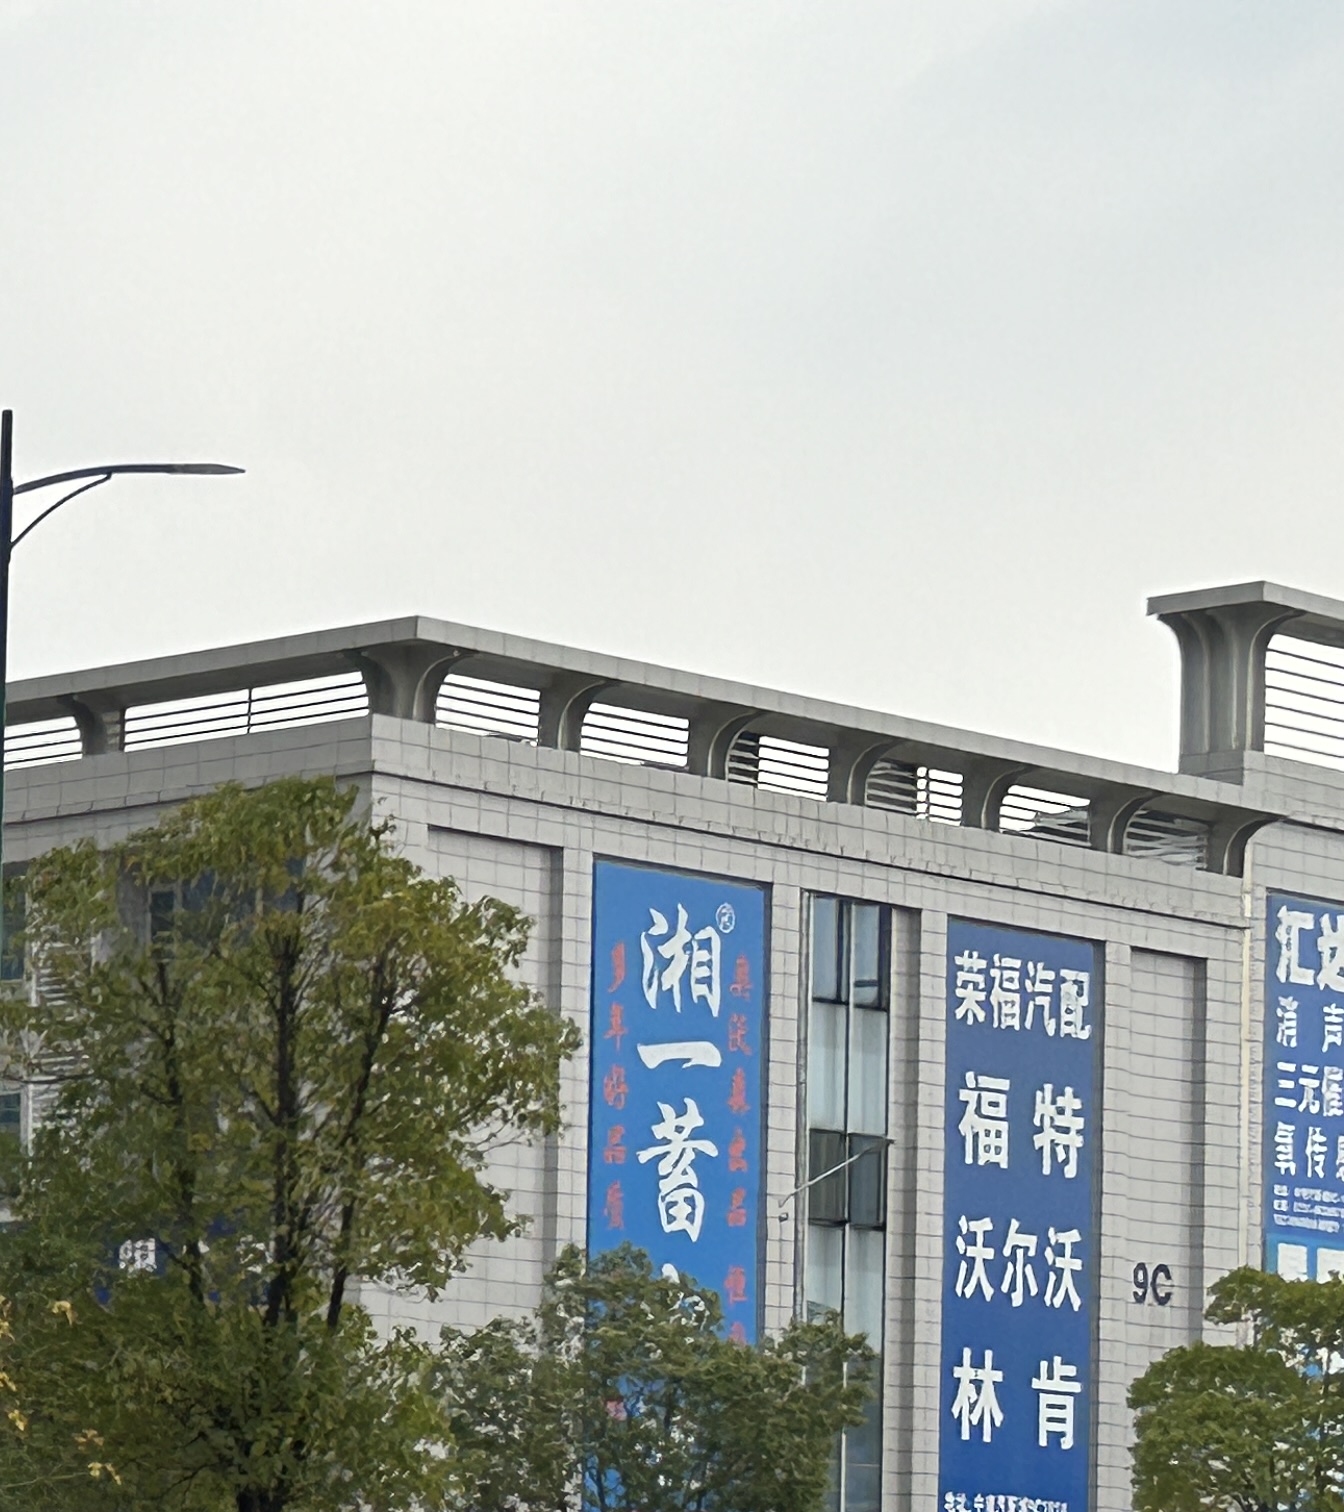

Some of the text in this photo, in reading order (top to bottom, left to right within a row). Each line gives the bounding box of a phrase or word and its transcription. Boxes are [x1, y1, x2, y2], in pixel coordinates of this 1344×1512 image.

[953, 950, 1092, 1040] 荣福汽配
[635, 903, 723, 1283] 湘一蓄
[958, 1070, 1085, 1179] 福特
[955, 1214, 1083, 1312] 沃尔沃
[1132, 1262, 1173, 1306] 9C
[950, 1346, 1083, 1450] 林肯
